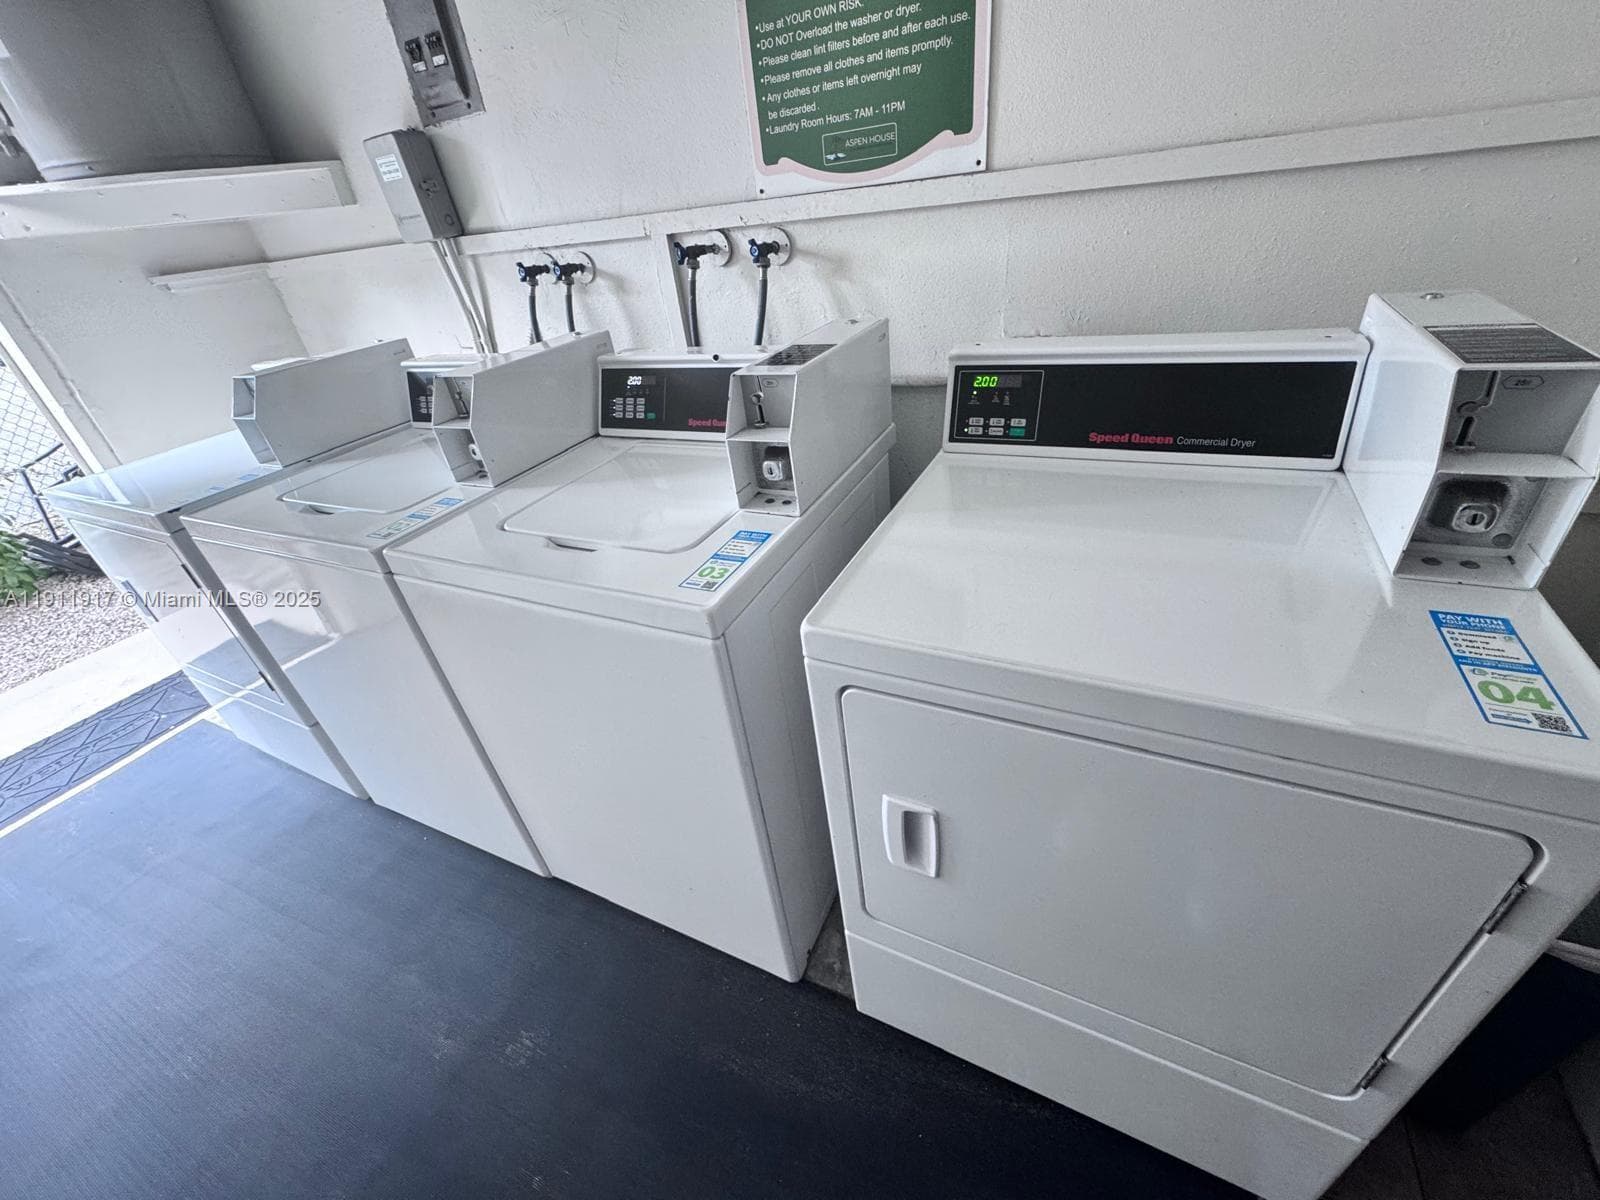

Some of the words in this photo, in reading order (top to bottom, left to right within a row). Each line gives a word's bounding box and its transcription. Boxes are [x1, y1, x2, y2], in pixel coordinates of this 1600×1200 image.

[758, 22, 775, 33] Use
[776, 18, 785, 29] at
[785, 9, 812, 26] YOUR
[813, 3, 837, 19] OWN
[760, 37, 774, 50] DO
[776, 32, 794, 47] NOT
[796, 23, 833, 41] Overload
[835, 20, 848, 32] the
[850, 12, 882, 28] washer
[884, 9, 894, 20] or
[895, 2, 922, 18] dryer.
[762, 54, 789, 67] Please
[791, 48, 813, 61] clean
[813, 43, 827, 56] lint
[828, 38, 851, 53] filters
[852, 32, 880, 47] before
[882, 25, 899, 40] and
[901, 22, 923, 35] after
[924, 14, 948, 30] each
[950, 11, 971, 24] use.
[764, 72, 791, 85] Please
[792, 65, 821, 80] remove
[823, 60, 833, 73] all
[834, 55, 865, 70] clothes
[866, 49, 884, 63] and
[885, 45, 910, 60] items
[911, 34, 953, 55] promptly.
[766, 92, 782, 104] Any
[783, 86, 811, 100] clothes
[812, 84, 821, 94] or
[822, 79, 845, 92] items
[846, 74, 859, 87] left
[860, 65, 901, 83] overnight
[903, 62, 922, 75] may
[767, 110, 778, 120] be
[769, 121, 800, 136] Laundry
[801, 118, 825, 129] Room
[826, 111, 852, 125] Hours:
[853, 105, 874, 119] 7AM
[881, 100, 906, 114] 11PM
[845, 136, 868, 149] ASPEN
[869, 131, 896, 145] HOUSE
[973, 375, 998, 388] 2.00
[687, 417, 711, 428] Speed
[1088, 431, 1130, 444] Speed
[1131, 433, 1173, 445] Queen
[1177, 435, 1229, 447] Commercial
[1230, 437, 1257, 449] Dryer
[697, 566, 730, 580] 03
[1437, 613, 1463, 621] PAY
[1465, 616, 1503, 626] WITH
[1470, 621, 1507, 630] PHONE
[1477, 680, 1556, 710] 04
